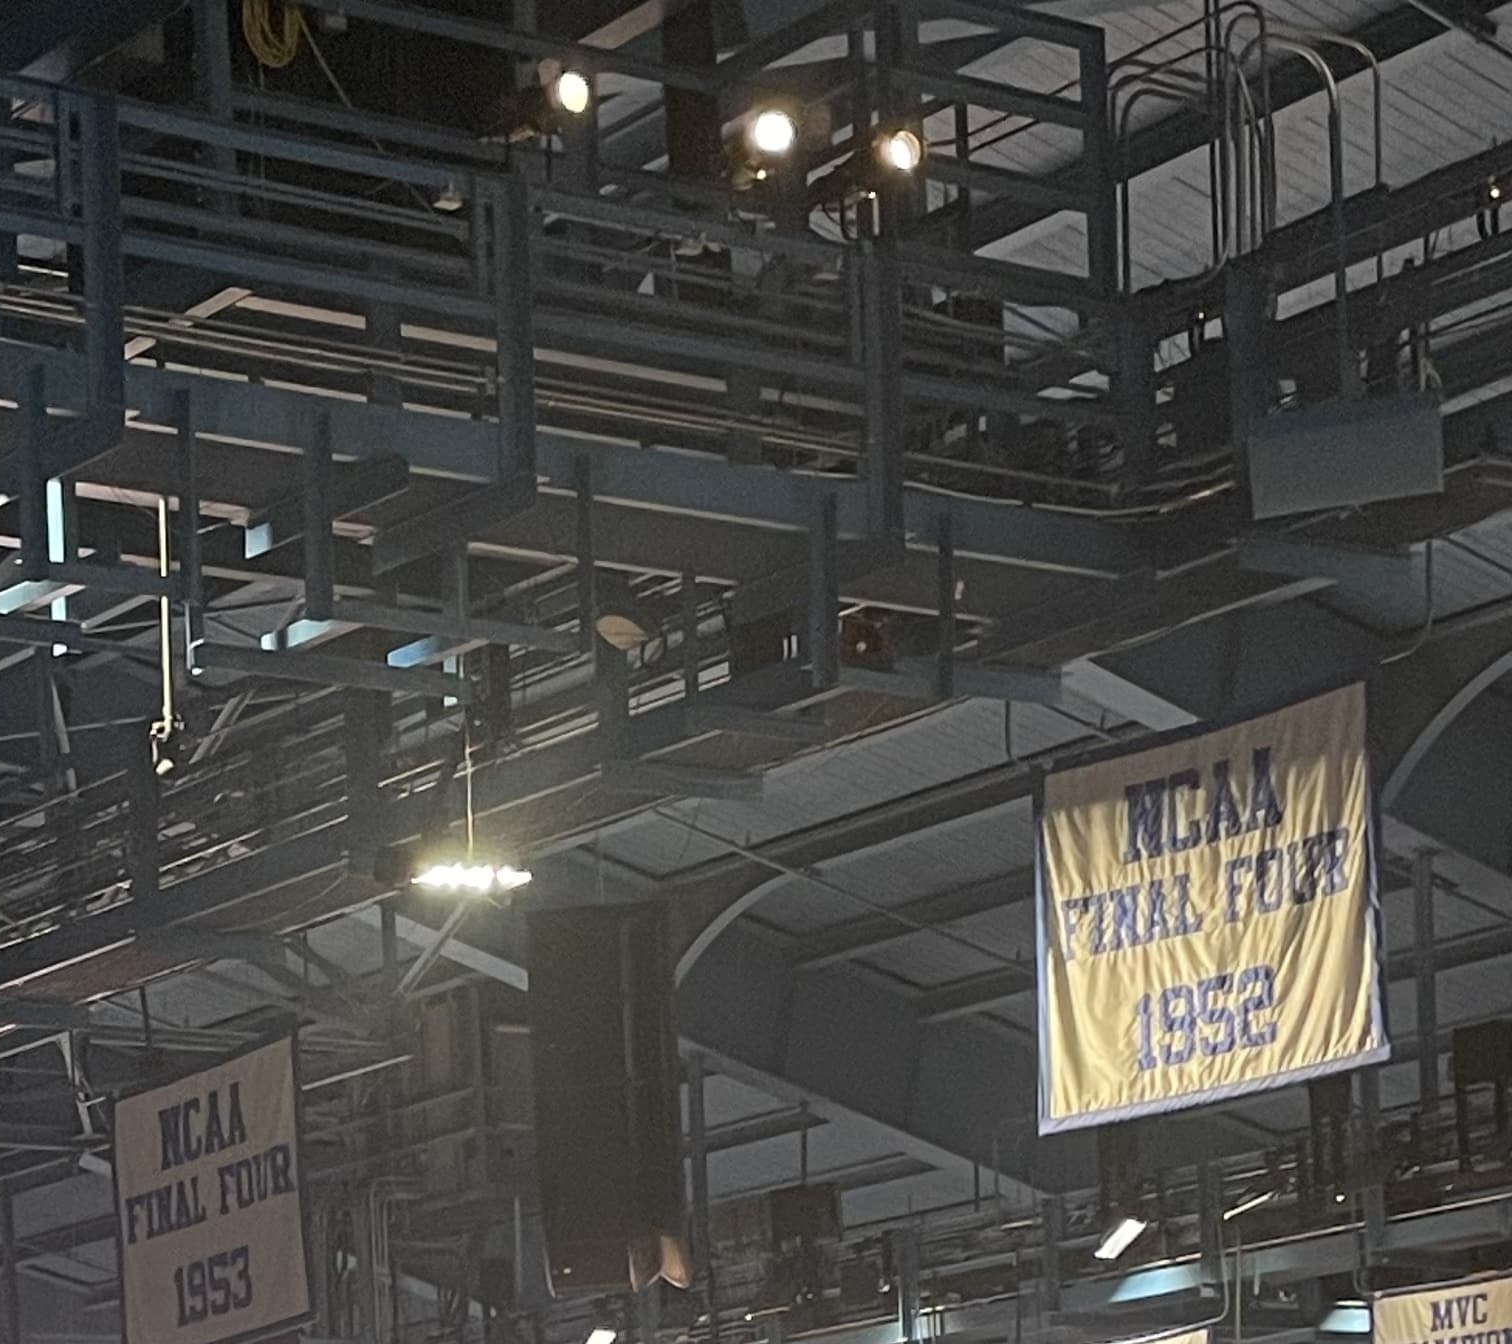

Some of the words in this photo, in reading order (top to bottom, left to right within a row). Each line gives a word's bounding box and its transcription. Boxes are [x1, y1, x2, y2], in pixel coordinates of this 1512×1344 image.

[1123, 746, 1283, 864] NCAA
[1062, 873, 1203, 961] FINAL
[1224, 827, 1349, 924] FOUR
[1136, 965, 1277, 1073] 1952
[158, 1082, 246, 1171] NCAA
[128, 1176, 207, 1244] FINAL
[218, 1144, 290, 1215] FOUR
[174, 1246, 253, 1327] 1953
[1430, 1293, 1488, 1332] MVC
